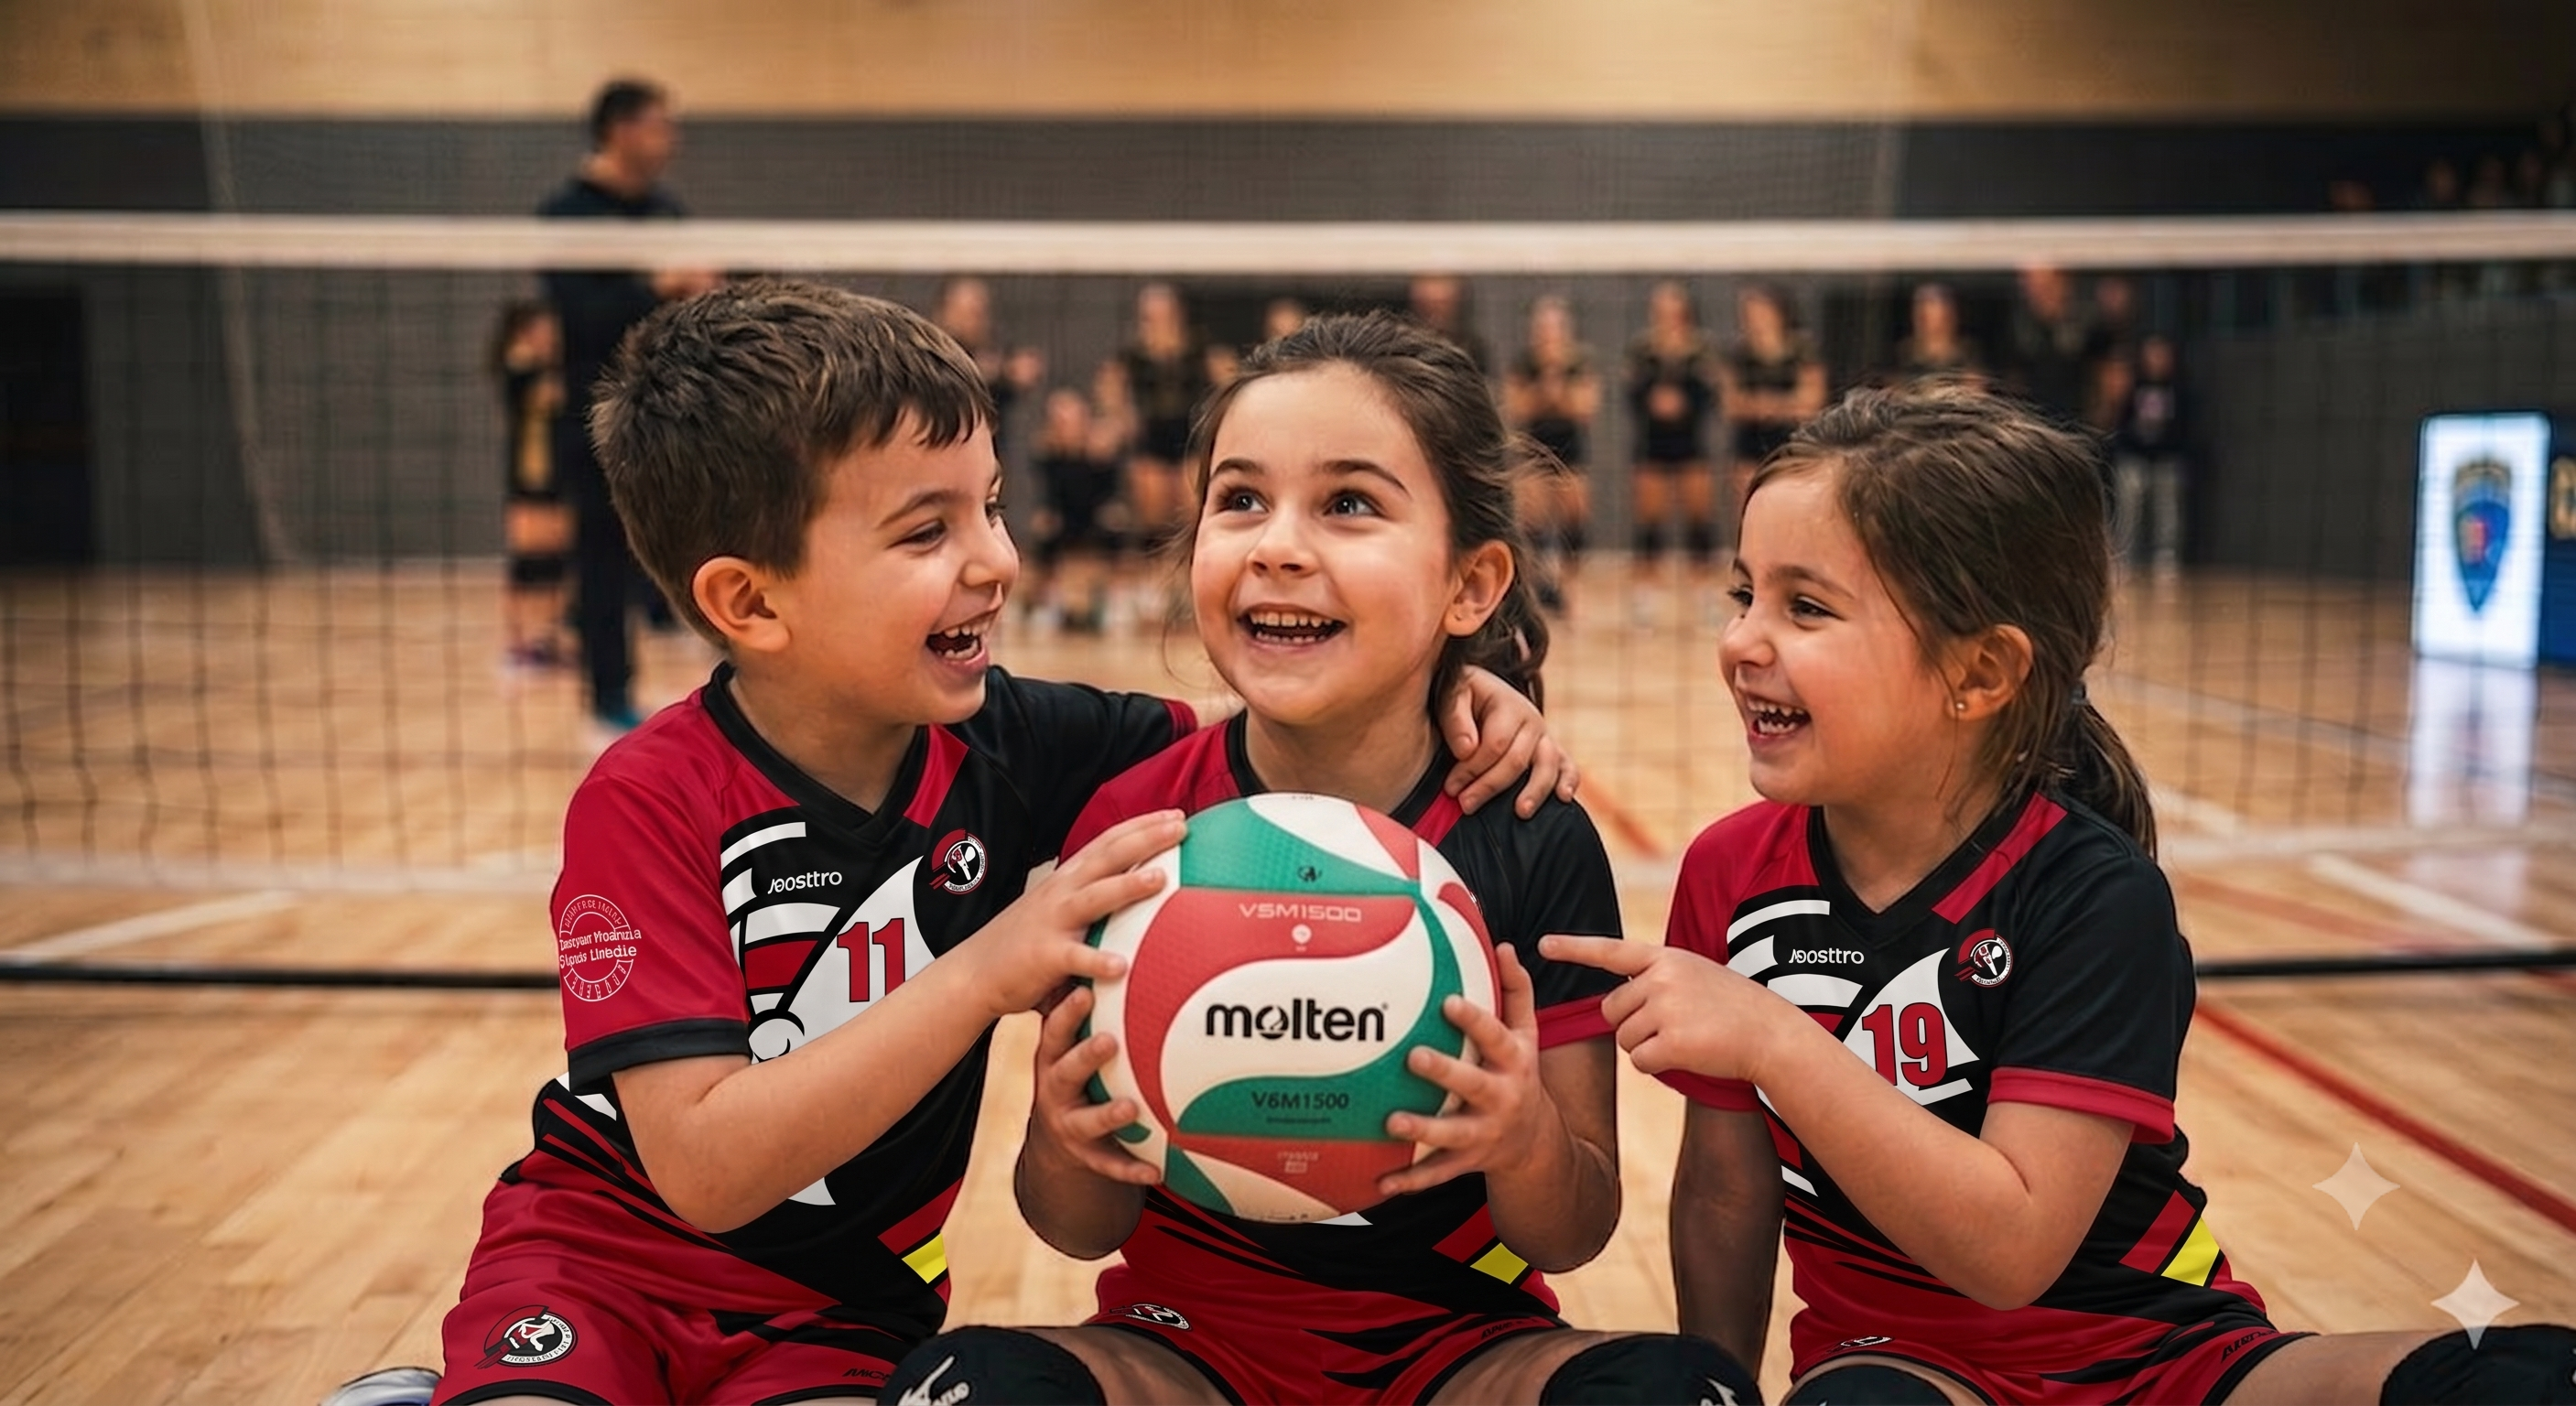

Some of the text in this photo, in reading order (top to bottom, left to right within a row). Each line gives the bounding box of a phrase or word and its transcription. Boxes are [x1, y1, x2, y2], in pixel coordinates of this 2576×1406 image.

[837, 917, 905, 1003] 11
[1206, 998, 1384, 1042] molten
[1861, 1001, 1948, 1087] 19
[1251, 1090, 1350, 1110] V6M1500
